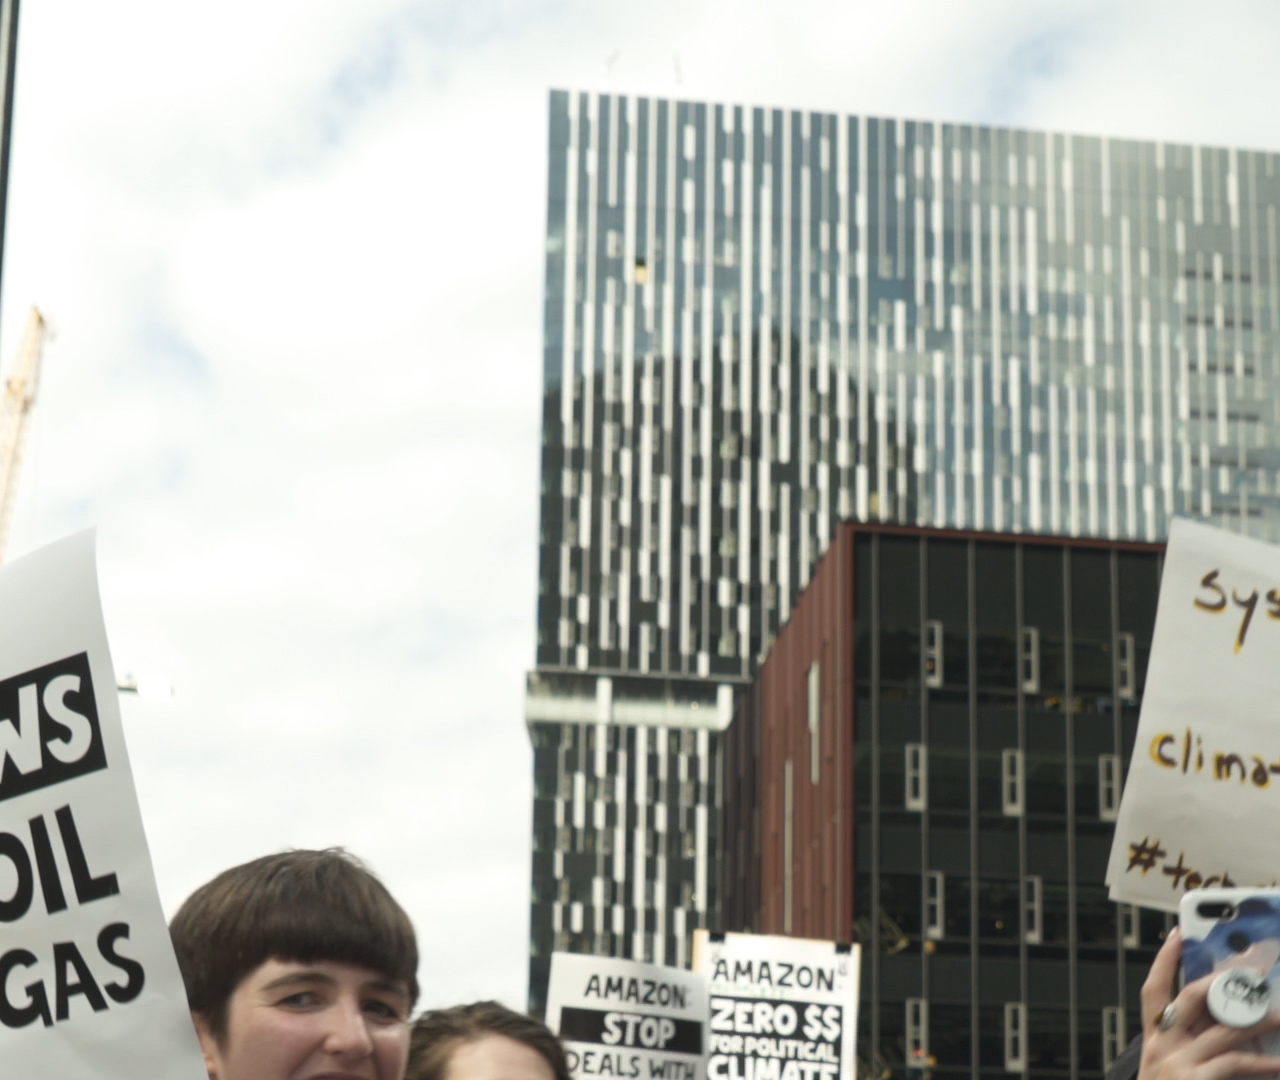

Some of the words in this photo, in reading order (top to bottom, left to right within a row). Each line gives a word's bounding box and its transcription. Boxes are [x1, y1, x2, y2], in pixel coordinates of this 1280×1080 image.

[601, 1011, 676, 1048] STOP
[710, 997, 797, 1036] ZERO
[802, 1003, 841, 1042] $$
[710, 1033, 743, 1054] FOR
[744, 1036, 839, 1064] POLITICAL
